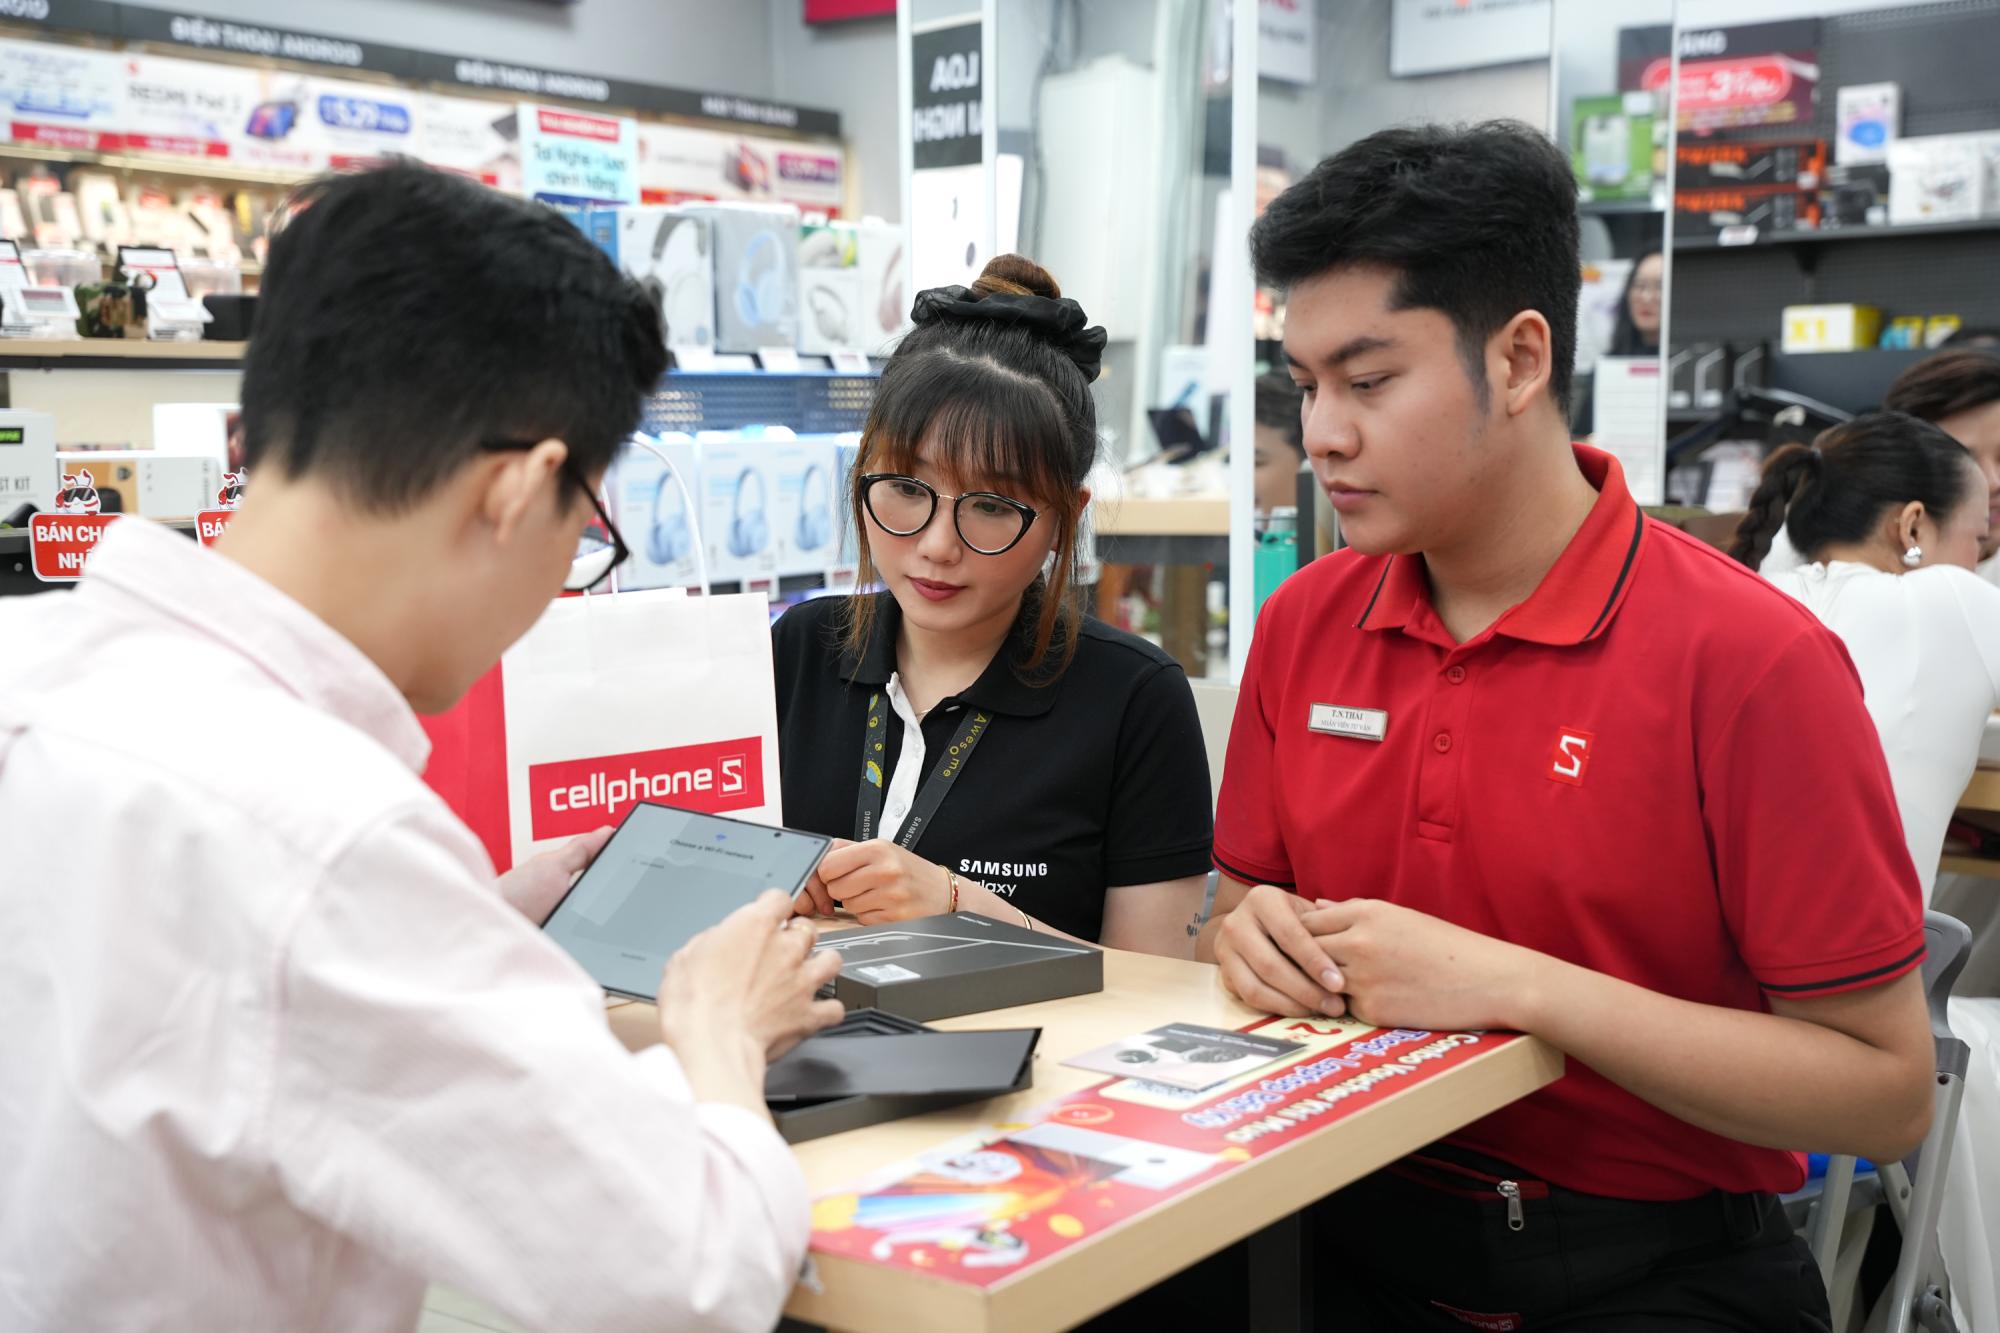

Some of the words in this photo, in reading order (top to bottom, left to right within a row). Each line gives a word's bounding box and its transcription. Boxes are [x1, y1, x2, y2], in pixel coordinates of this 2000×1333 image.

[170, 15, 221, 47] ĐIỆN
[282, 32, 364, 66] ANDROID
[544, 72, 610, 102] ANDROID
[35, 521, 73, 542] BÁN
[202, 518, 228, 537] BÁ
[943, 713, 987, 777] Awesome
[1553, 735, 1587, 778] S
[669, 839, 697, 849] Choose
[959, 858, 1048, 877] SAMSUNG
[973, 879, 1017, 898] laxy
[1397, 1033, 1480, 1065] Combo
[1259, 1057, 1361, 1094] Laptop
[1315, 1062, 1418, 1102] Voucher
[1276, 1098, 1334, 1121] Khi
